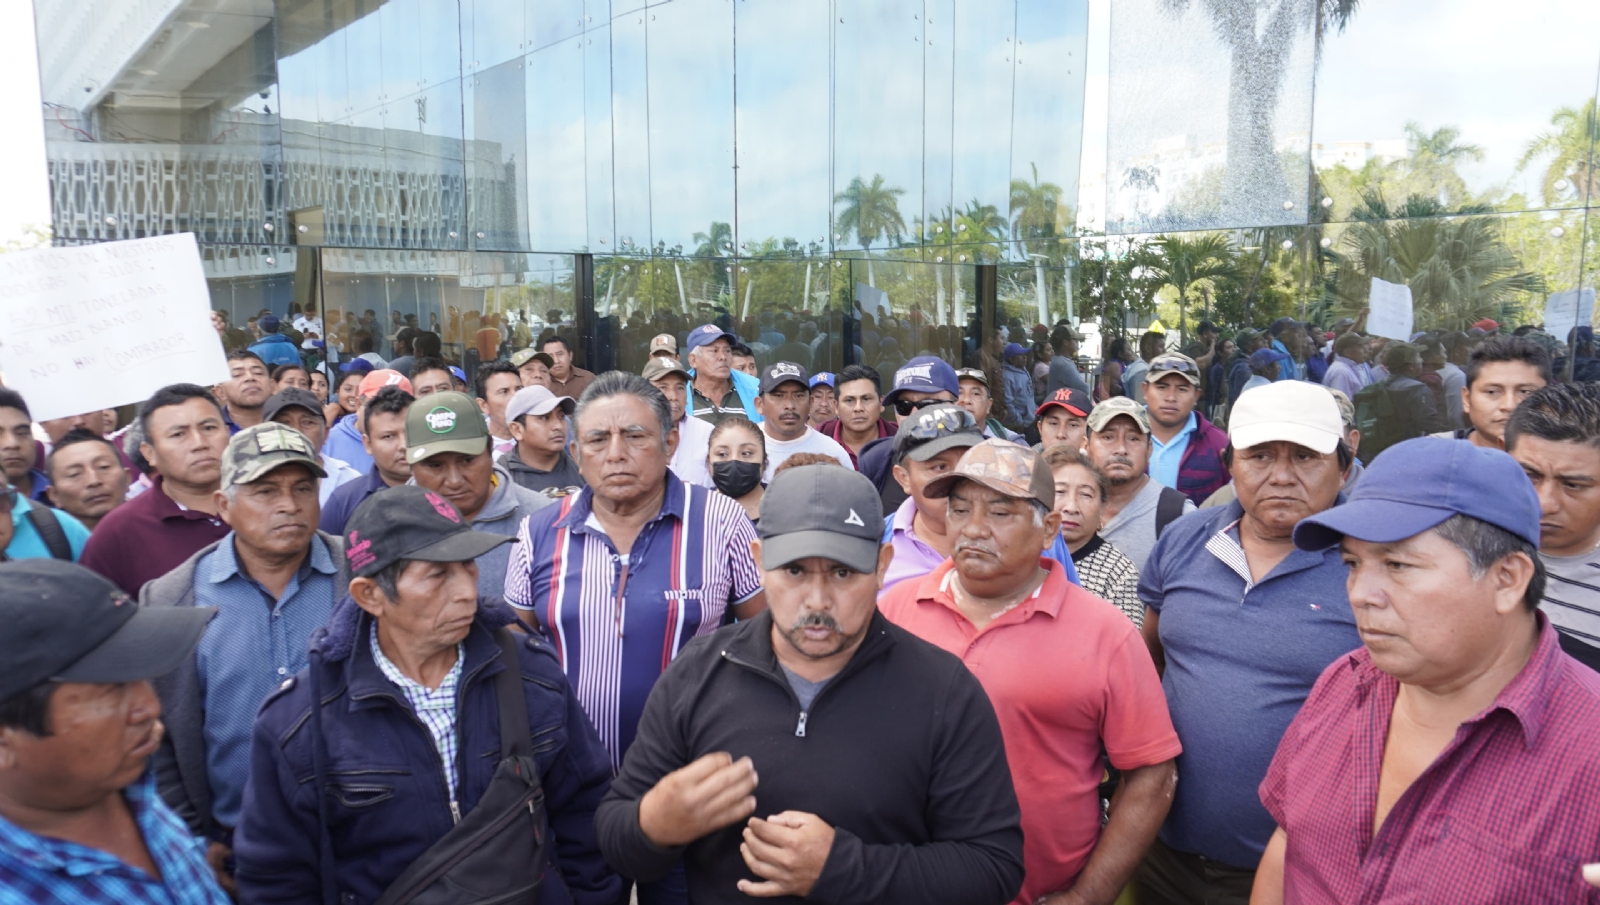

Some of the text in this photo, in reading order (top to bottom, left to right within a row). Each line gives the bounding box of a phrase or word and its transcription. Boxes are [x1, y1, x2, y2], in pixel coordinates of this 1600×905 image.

[77, 251, 99, 266] EN
[104, 240, 176, 261] NUESTRAS
[9, 283, 168, 329] 52 MIL TONELADAS
[12, 341, 34, 356] DE
[87, 310, 143, 335] BLANCO
[29, 362, 60, 380] NO
[1054, 388, 1072, 400] NY
[425, 412, 456, 422] CAMPO
[919, 408, 958, 431] CAT
